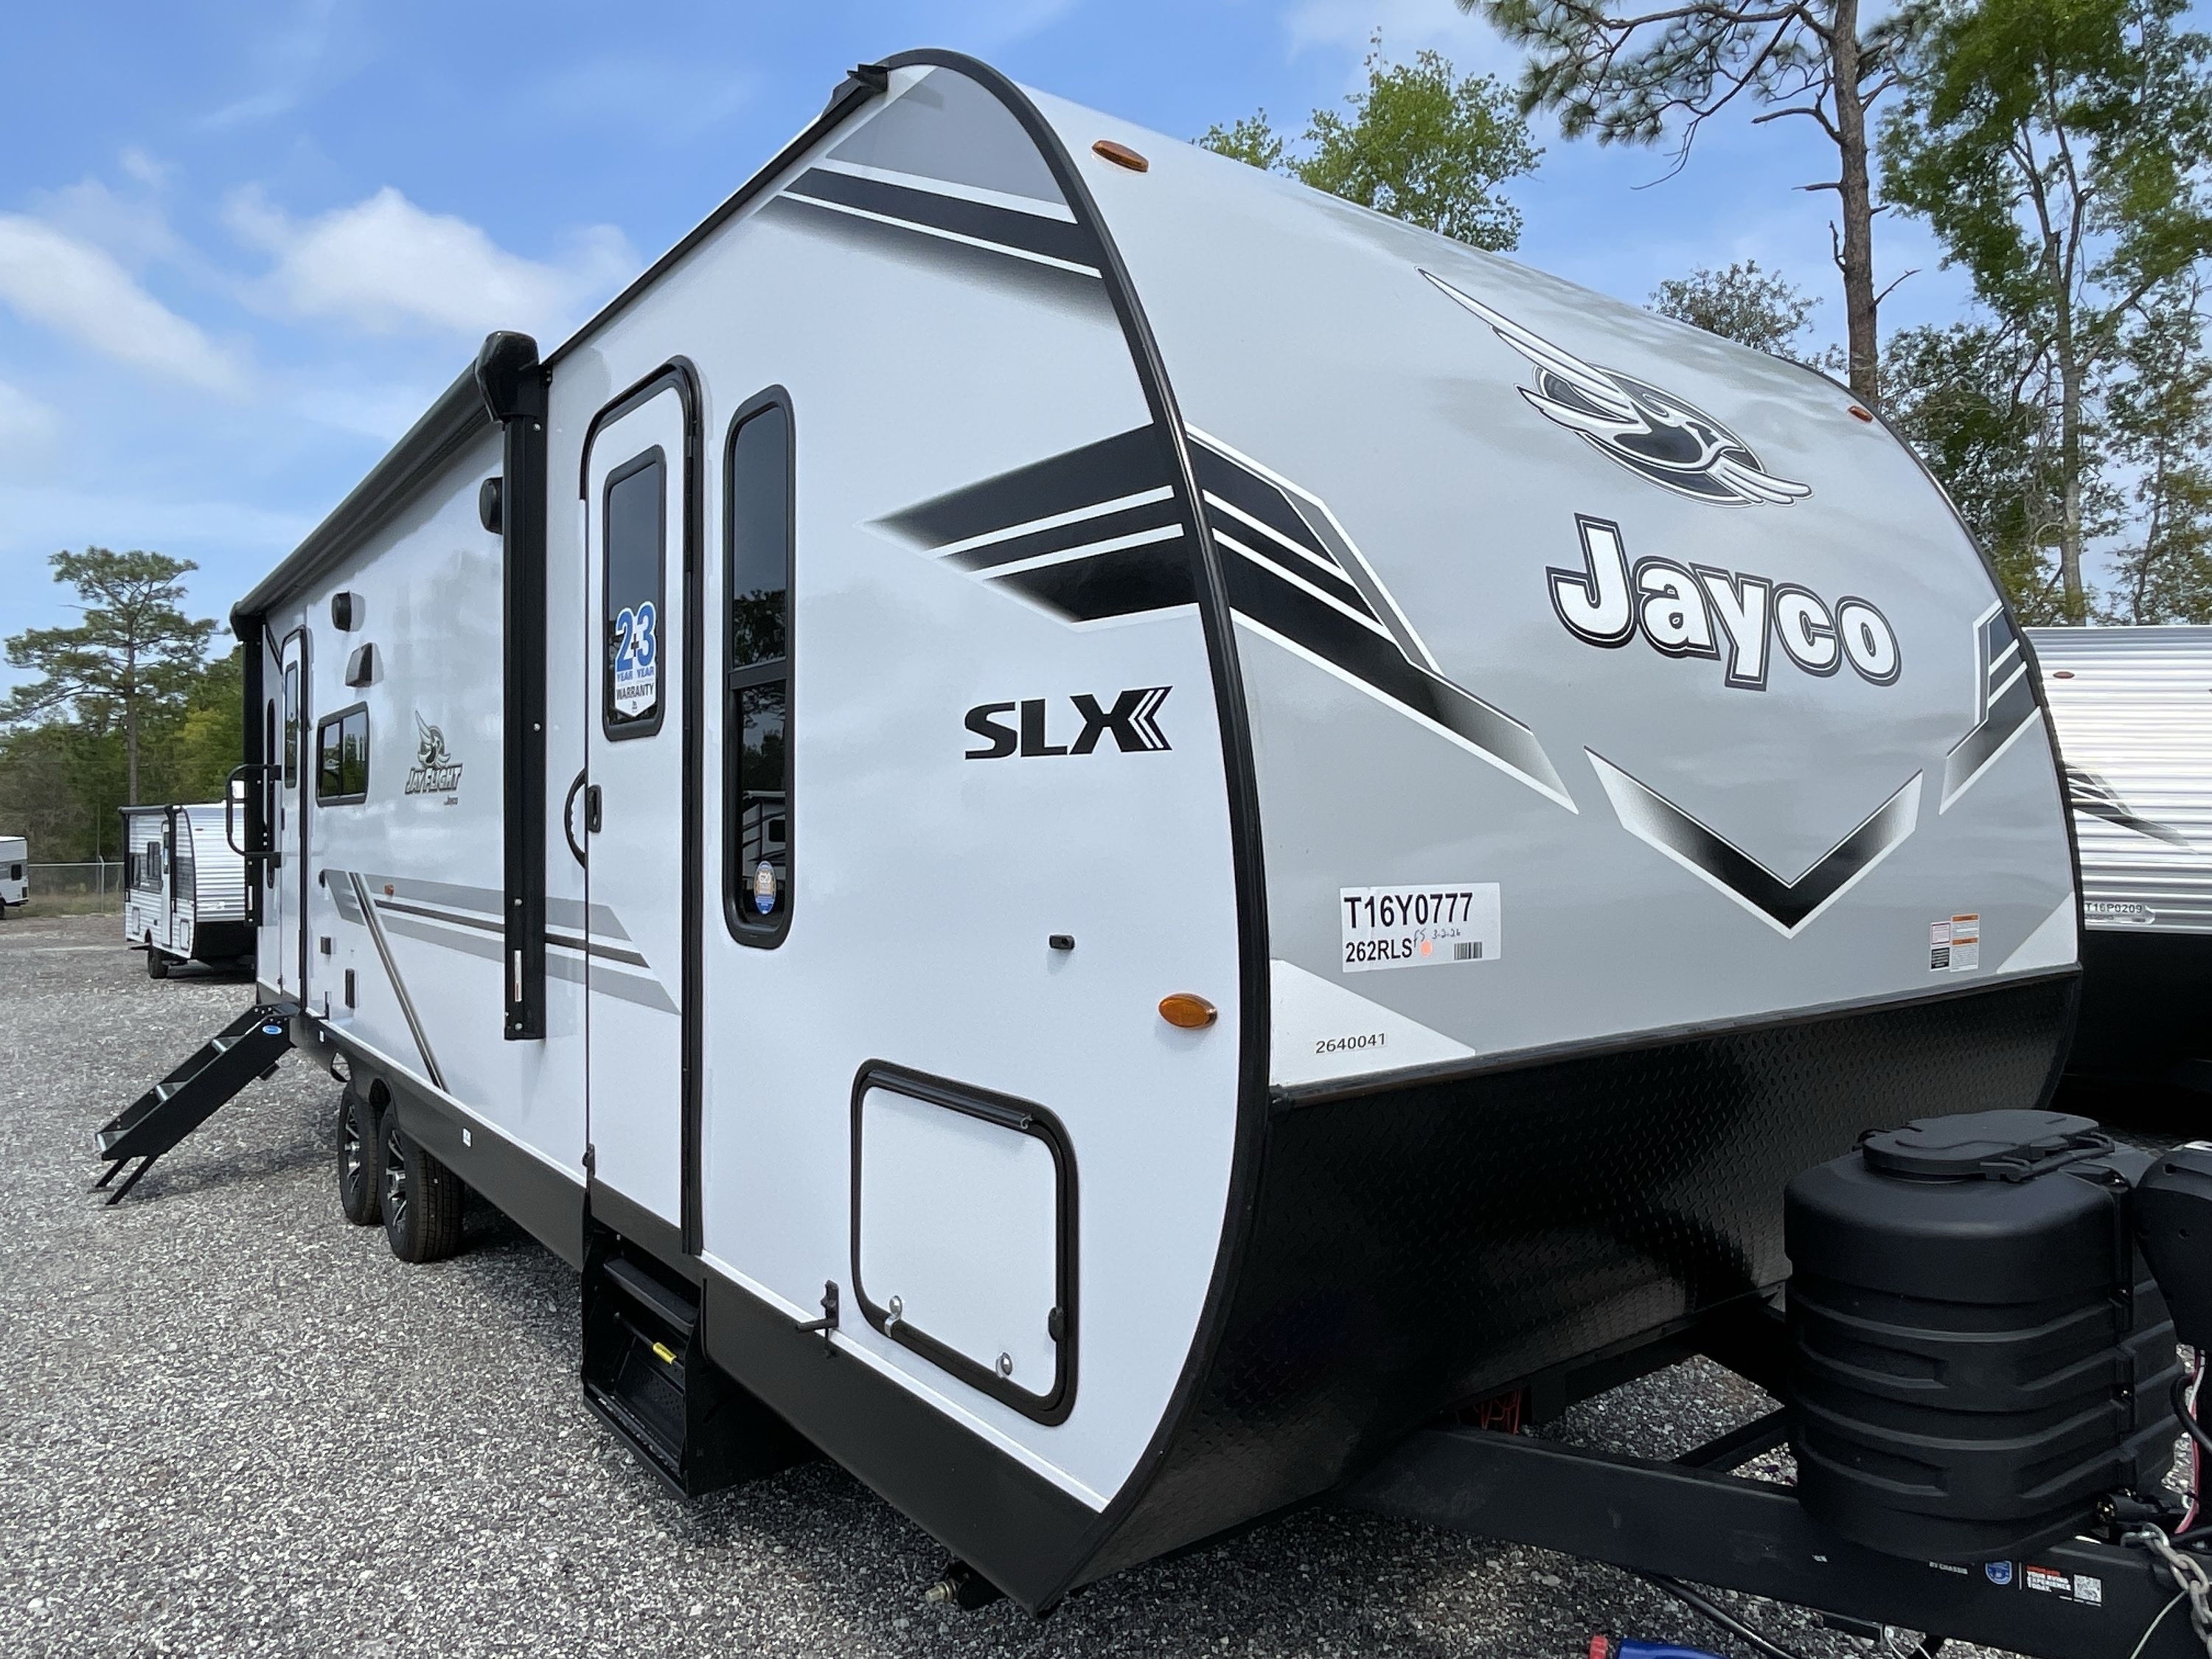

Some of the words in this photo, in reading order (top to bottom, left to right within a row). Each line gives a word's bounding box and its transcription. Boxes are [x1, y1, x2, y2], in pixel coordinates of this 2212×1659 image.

[1545, 512, 1902, 692] Jayco
[616, 670, 633, 682] YEAR
[637, 666, 654, 678] YEAR
[616, 683, 654, 700] WARRANTY
[964, 686, 1173, 760] SLX
[1343, 892, 1473, 928] T16Y0777
[1346, 938, 1413, 963] 262RLS
[1315, 1033, 1386, 1054] 2640041
